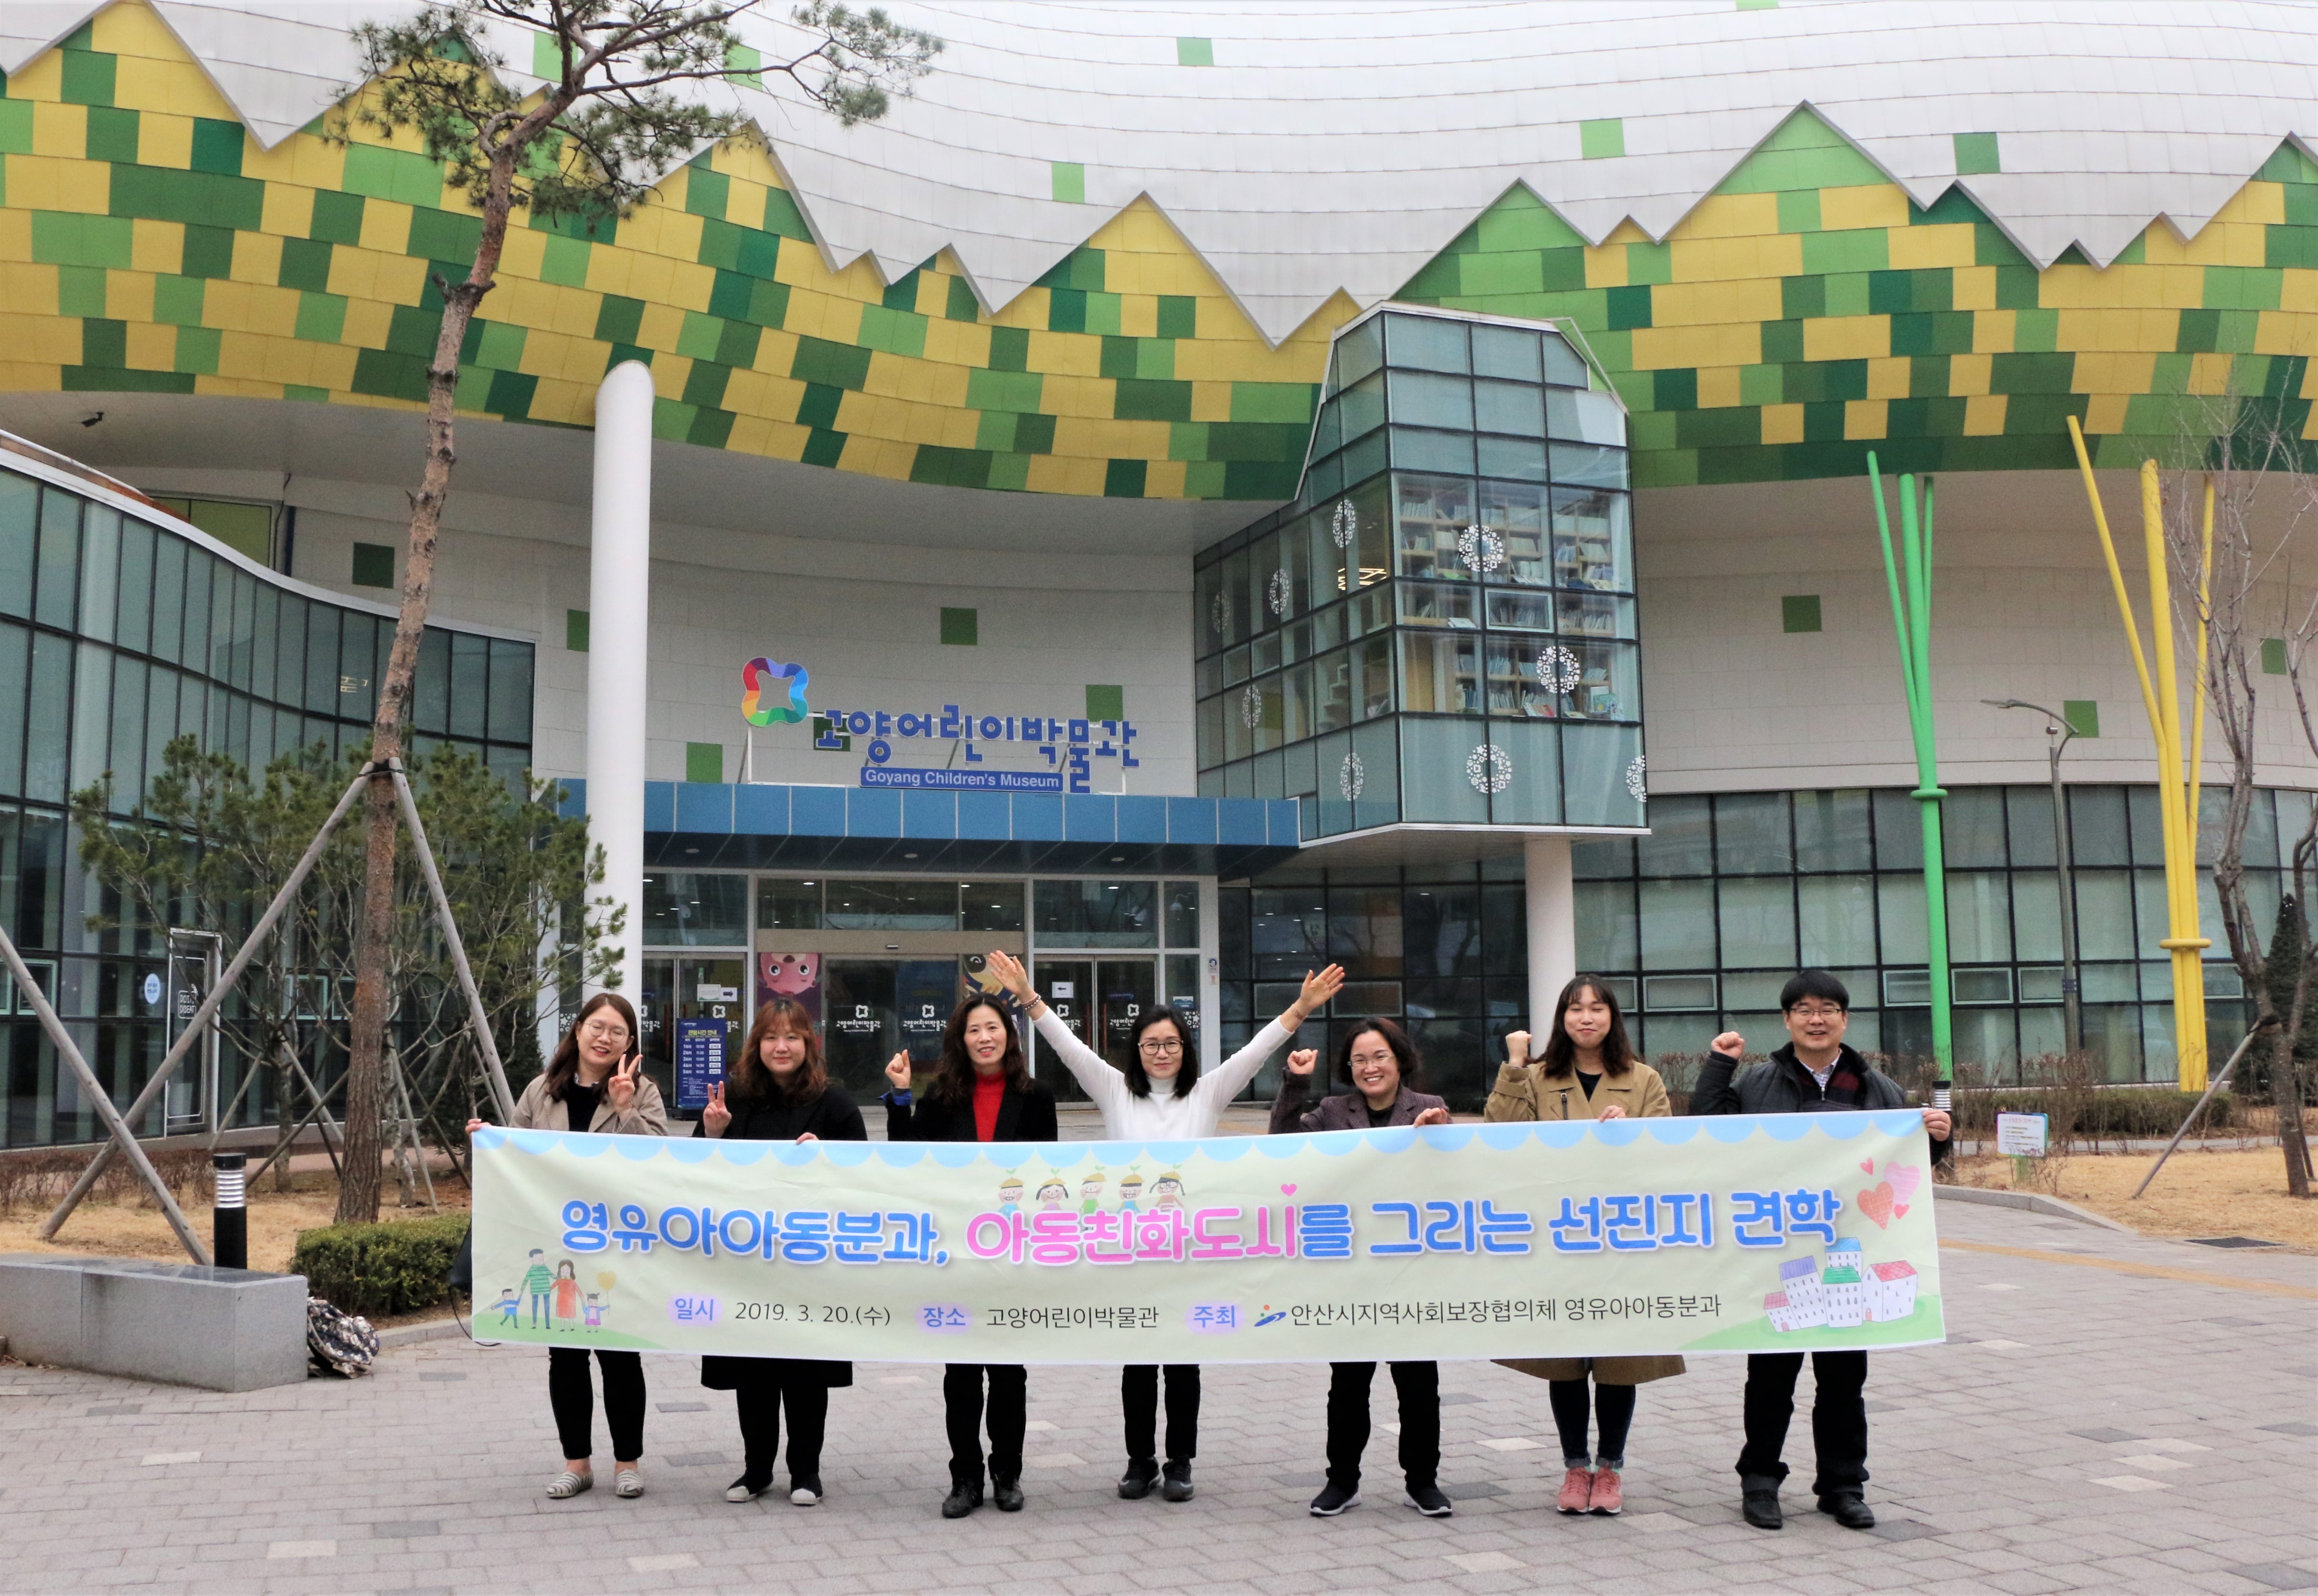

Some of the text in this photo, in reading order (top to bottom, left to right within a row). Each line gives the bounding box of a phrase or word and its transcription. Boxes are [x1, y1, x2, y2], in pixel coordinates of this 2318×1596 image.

[816, 704, 1139, 794] 고양어린이박물관
[865, 769, 1059, 787] Goyang Children's Museum
[836, 1019, 881, 1032] 고양어린이박물관
[903, 1019, 947, 1032] 고양어린이박물관
[1109, 1018, 1135, 1027] 고양어린이
[562, 1188, 1842, 1266] 영유아아동분과, 아동친화도시를 그리는 선진지 견학
[674, 1298, 715, 1321] 일시
[735, 1302, 891, 1327] 2019. 3. 20.(수)
[923, 1307, 967, 1328] 장소
[986, 1306, 1159, 1329] 고양어린이박물관
[1193, 1305, 1236, 1328] 주최
[1291, 1293, 1722, 1327] 안산시지역사회보장협의체 영유아아동분과
